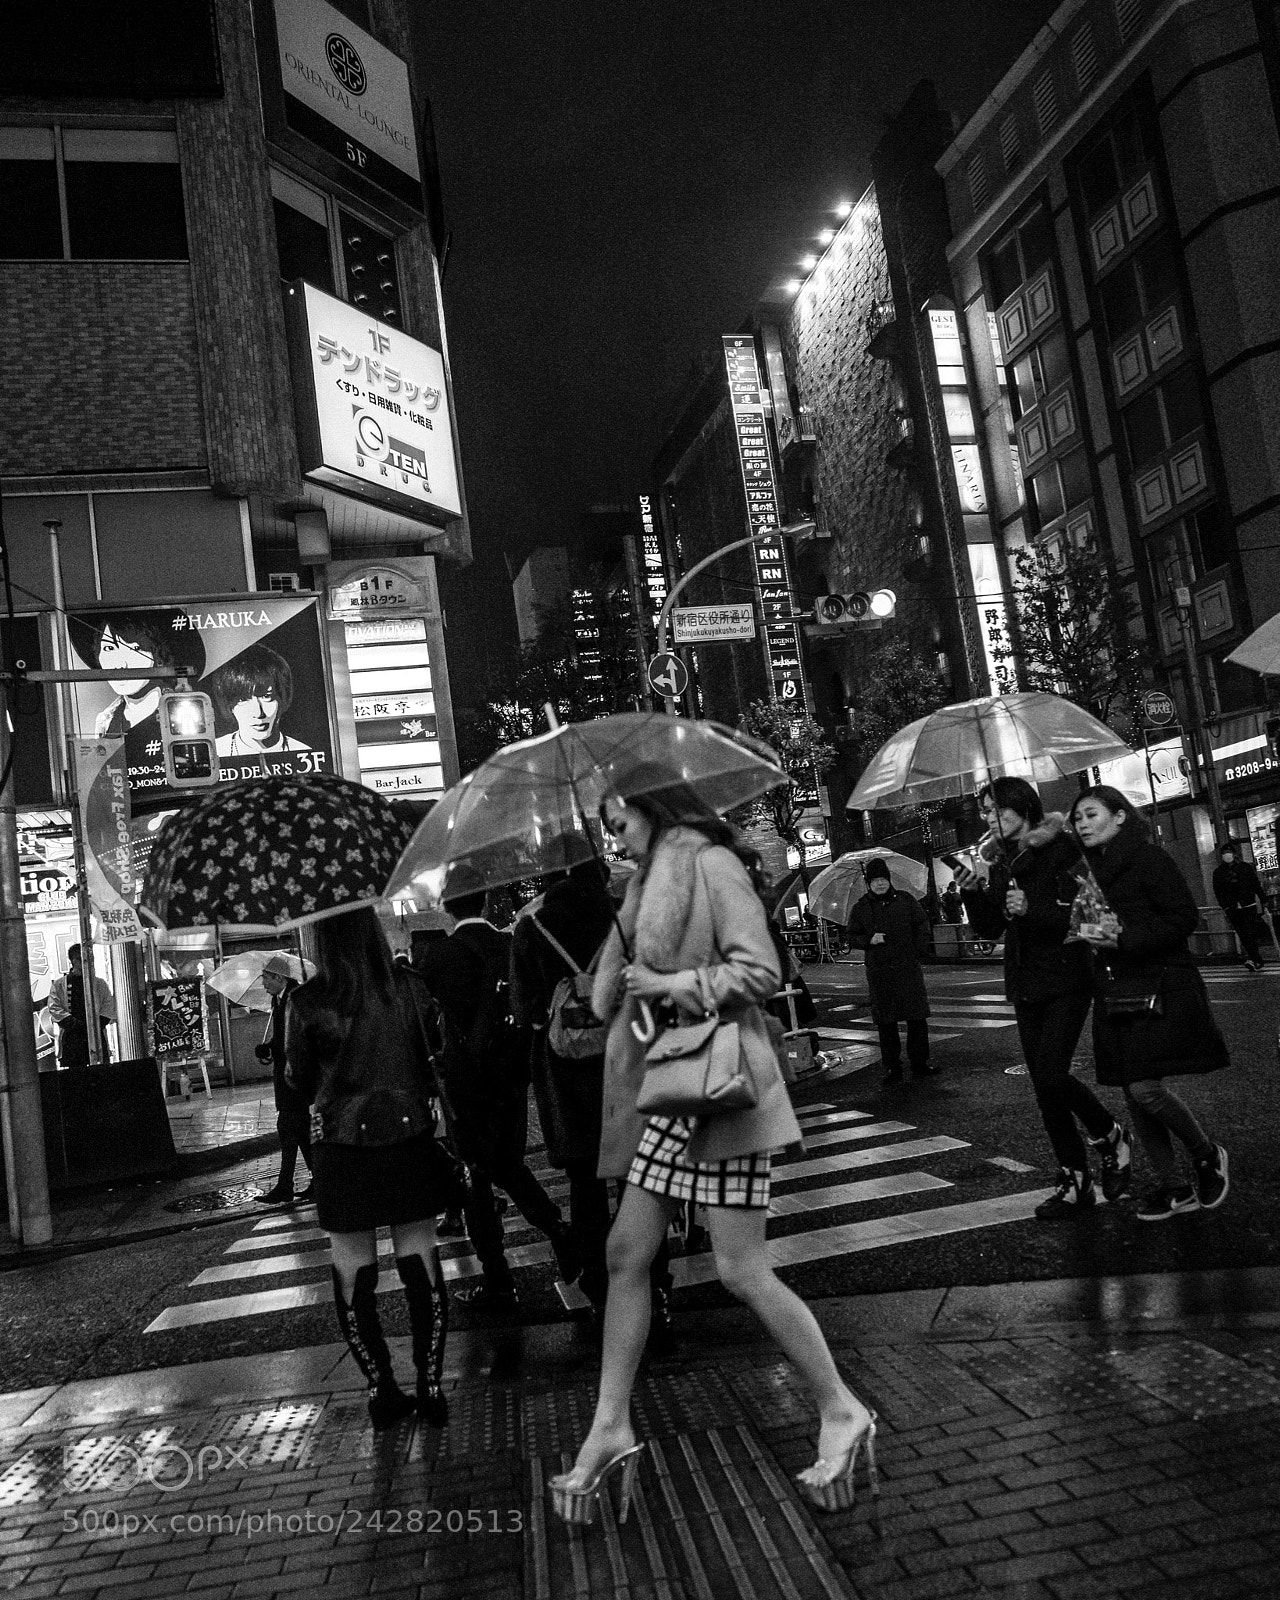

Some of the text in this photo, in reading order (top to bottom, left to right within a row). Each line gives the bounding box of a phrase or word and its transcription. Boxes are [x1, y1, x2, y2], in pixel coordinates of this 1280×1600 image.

[285, 52, 411, 150] ORIENTAL LOUNGE
[346, 142, 367, 168] 5F
[368, 328, 391, 355] 1F
[317, 334, 441, 410] テンドラッグ
[740, 426, 762, 434] Great
[742, 437, 764, 445] Great
[744, 449, 766, 457] Great
[389, 449, 428, 479] TEN
[953, 448, 985, 512] LINARIA
[759, 548, 779, 560] RN
[762, 568, 782, 579] RN
[171, 610, 272, 631] #HARUKA
[675, 609, 750, 628] 新宿区役所通り
[676, 626, 752, 638] Shinjukukuyakusho-dori
[770, 637, 795, 645] LEGEND
[782, 671, 792, 679] 1F
[1147, 702, 1172, 715] 消火栓
[296, 751, 326, 774] 3F
